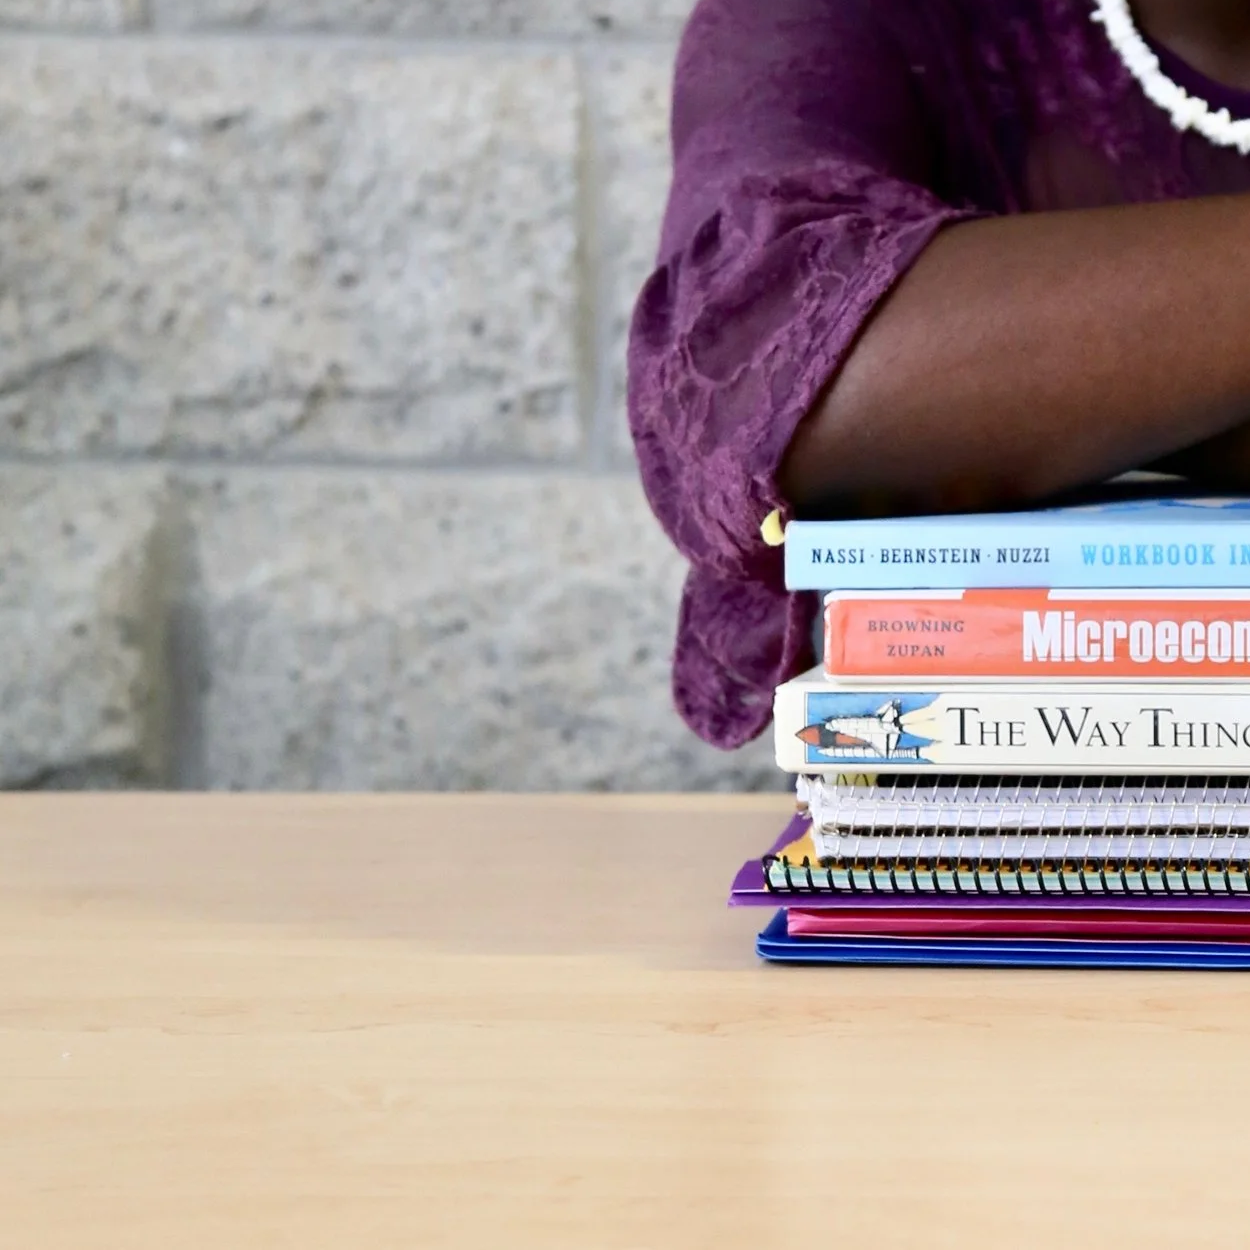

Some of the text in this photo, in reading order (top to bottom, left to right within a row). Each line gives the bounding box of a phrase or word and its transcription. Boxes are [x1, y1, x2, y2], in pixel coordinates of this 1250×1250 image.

[812, 547, 1050, 564] NASSI BERNSTEIN NUZZI
[1081, 544, 1215, 566] WORKBOOK
[868, 620, 965, 632] BROWNING
[887, 644, 945, 657] ZUPAN
[946, 707, 1026, 748] THE
[1034, 707, 1131, 748] WAY
